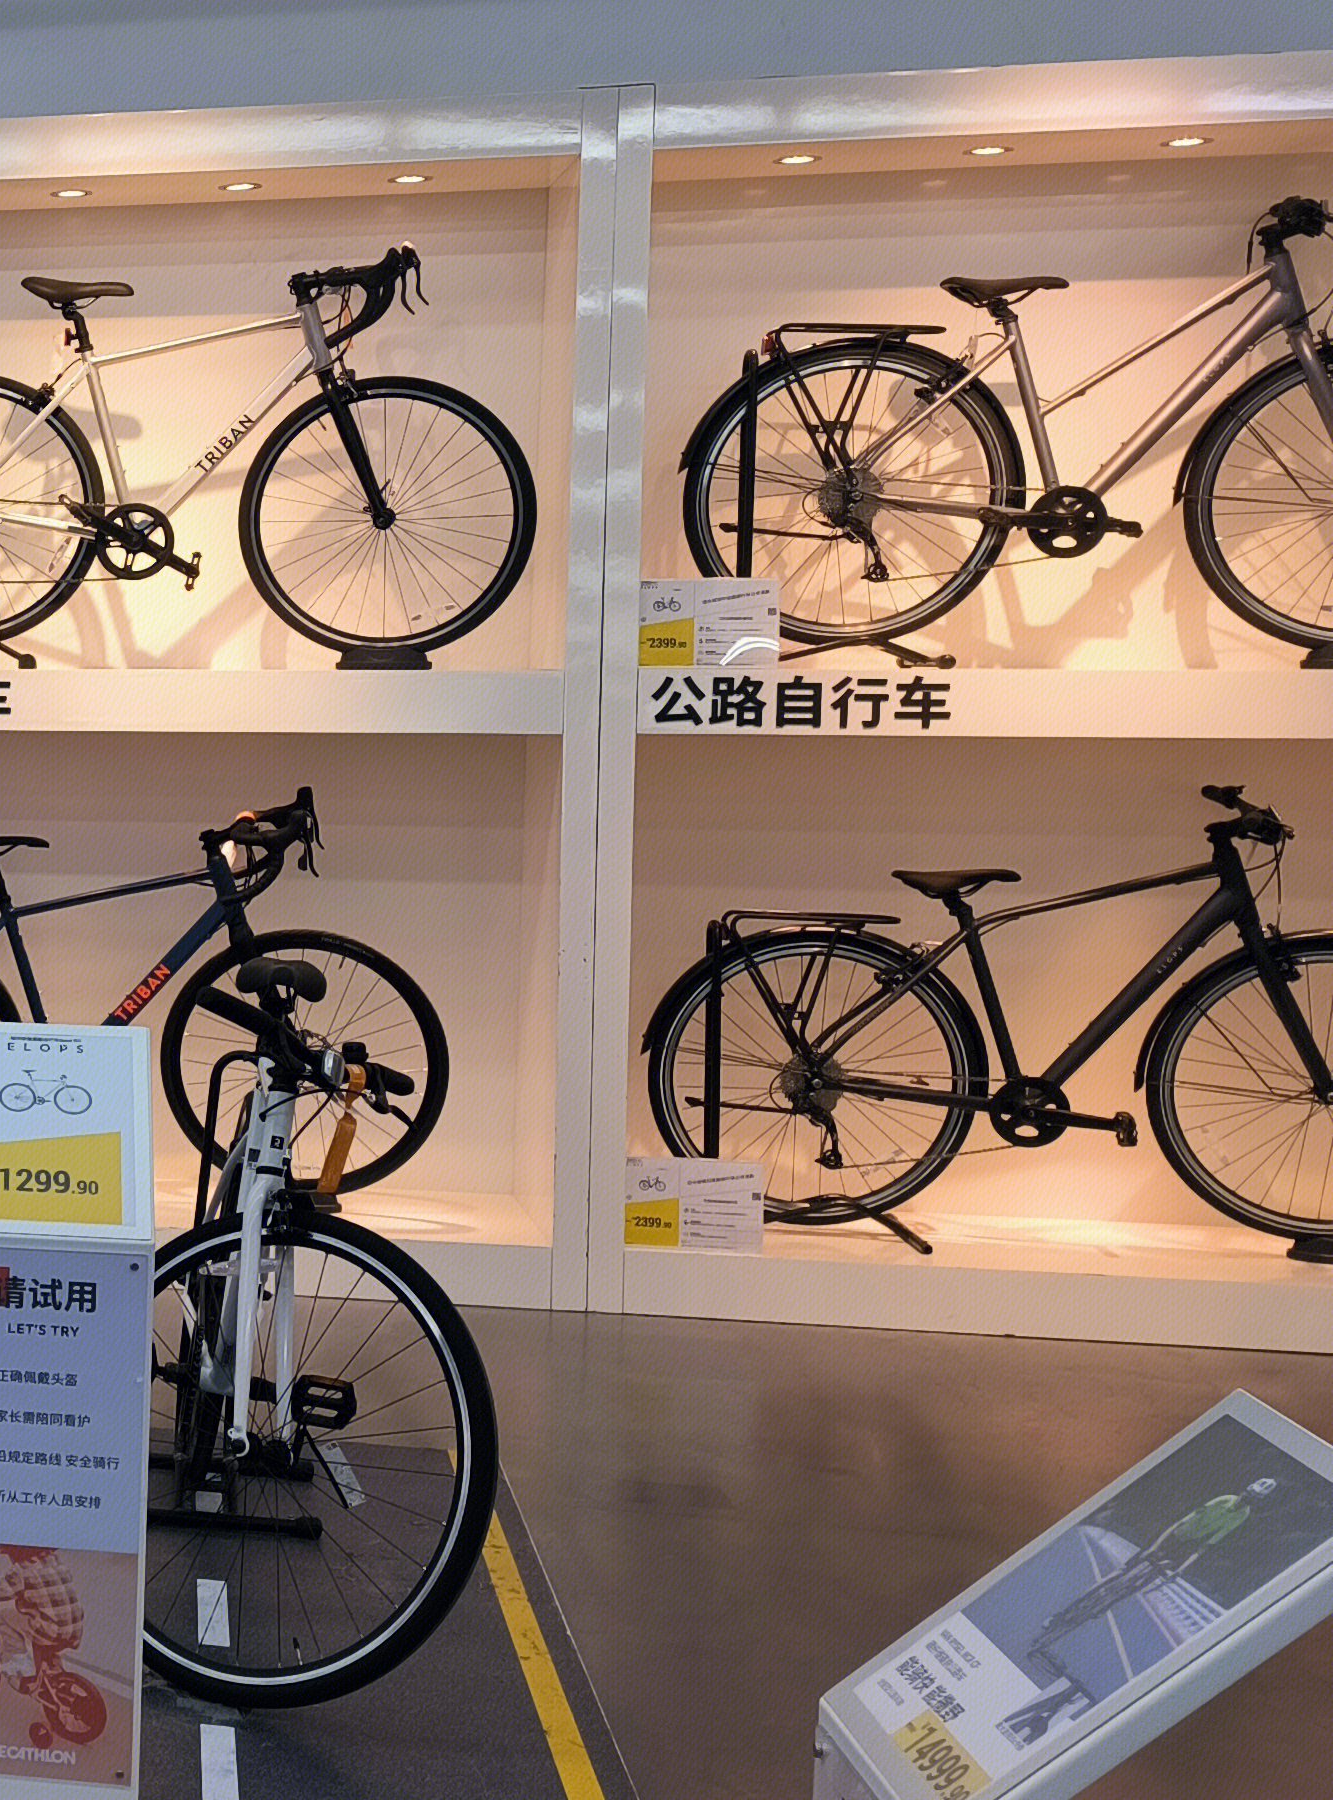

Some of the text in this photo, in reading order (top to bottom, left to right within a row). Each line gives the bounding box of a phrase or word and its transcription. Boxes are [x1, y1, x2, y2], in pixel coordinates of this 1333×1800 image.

[194, 414, 255, 473] TRIBAN
[651, 675, 952, 729] 公路自行车
[114, 962, 171, 1022] TRIBAN
[7, 1042, 84, 1054] ELOPS
[7, 1322, 81, 1338] LET'S TRY
